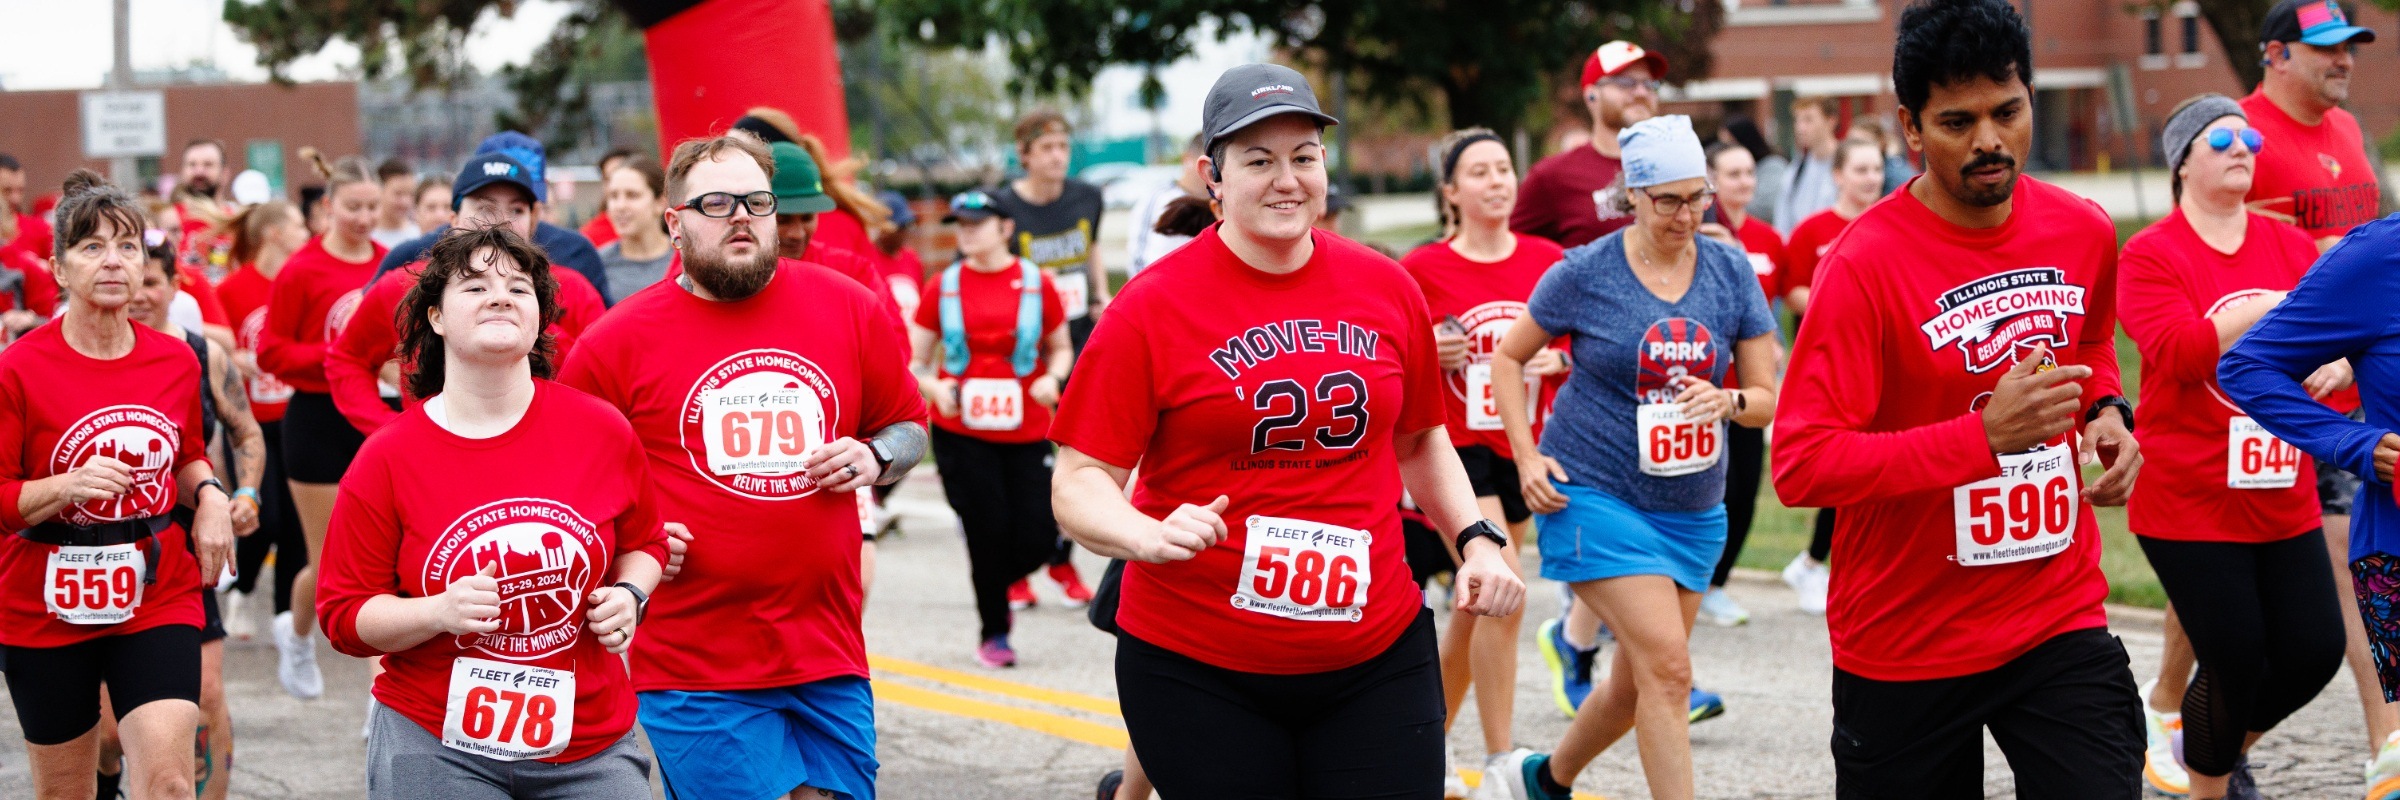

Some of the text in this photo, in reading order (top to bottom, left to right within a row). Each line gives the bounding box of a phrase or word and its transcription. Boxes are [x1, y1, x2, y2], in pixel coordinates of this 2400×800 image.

[1251, 84, 1294, 97] KIRKLAND
[2294, 183, 2377, 230] REDBIRD
[1953, 272, 2049, 304] ILLINOIS STATE
[1933, 288, 2078, 340] HOMECOMING
[1209, 319, 1378, 380] MOVE-IN
[1649, 341, 1707, 361] PARK
[1977, 314, 2054, 362] CELEBRATING RED
[718, 358, 753, 380] STATE
[756, 356, 831, 399] HOMECOMING
[1666, 365, 1688, 388] 2
[719, 396, 799, 406] FLEET FEET
[971, 395, 1014, 419] 844
[1235, 370, 1370, 455] '23
[57, 425, 94, 464] ILLINOIS
[92, 412, 124, 429] STATE
[721, 410, 806, 458] 679
[1650, 422, 1715, 463] 656
[721, 459, 805, 471] www.fleetfeetbloomington.c
[1230, 459, 1275, 470] ILLINOIS
[1278, 459, 1312, 469] STATE
[2036, 455, 2062, 473] FEET
[2241, 436, 2297, 475] 644
[732, 474, 767, 493] RELIVE
[769, 479, 789, 494] THE
[1969, 475, 2070, 546] 596
[430, 505, 594, 581] ILLINOIS STATE HOMECOMING
[1266, 526, 1309, 541] FLEET
[1326, 533, 1356, 549] FEET
[59, 551, 131, 562] FLEET FEET
[55, 565, 137, 610] 559
[537, 573, 563, 586] 2024
[1252, 545, 1358, 609] 586
[1249, 598, 1347, 618] www.fleetfeetblington.com
[510, 636, 529, 653] THE
[530, 620, 578, 652] MOMENTS
[470, 667, 560, 689] FLEET FEET
[461, 685, 557, 748] 678
